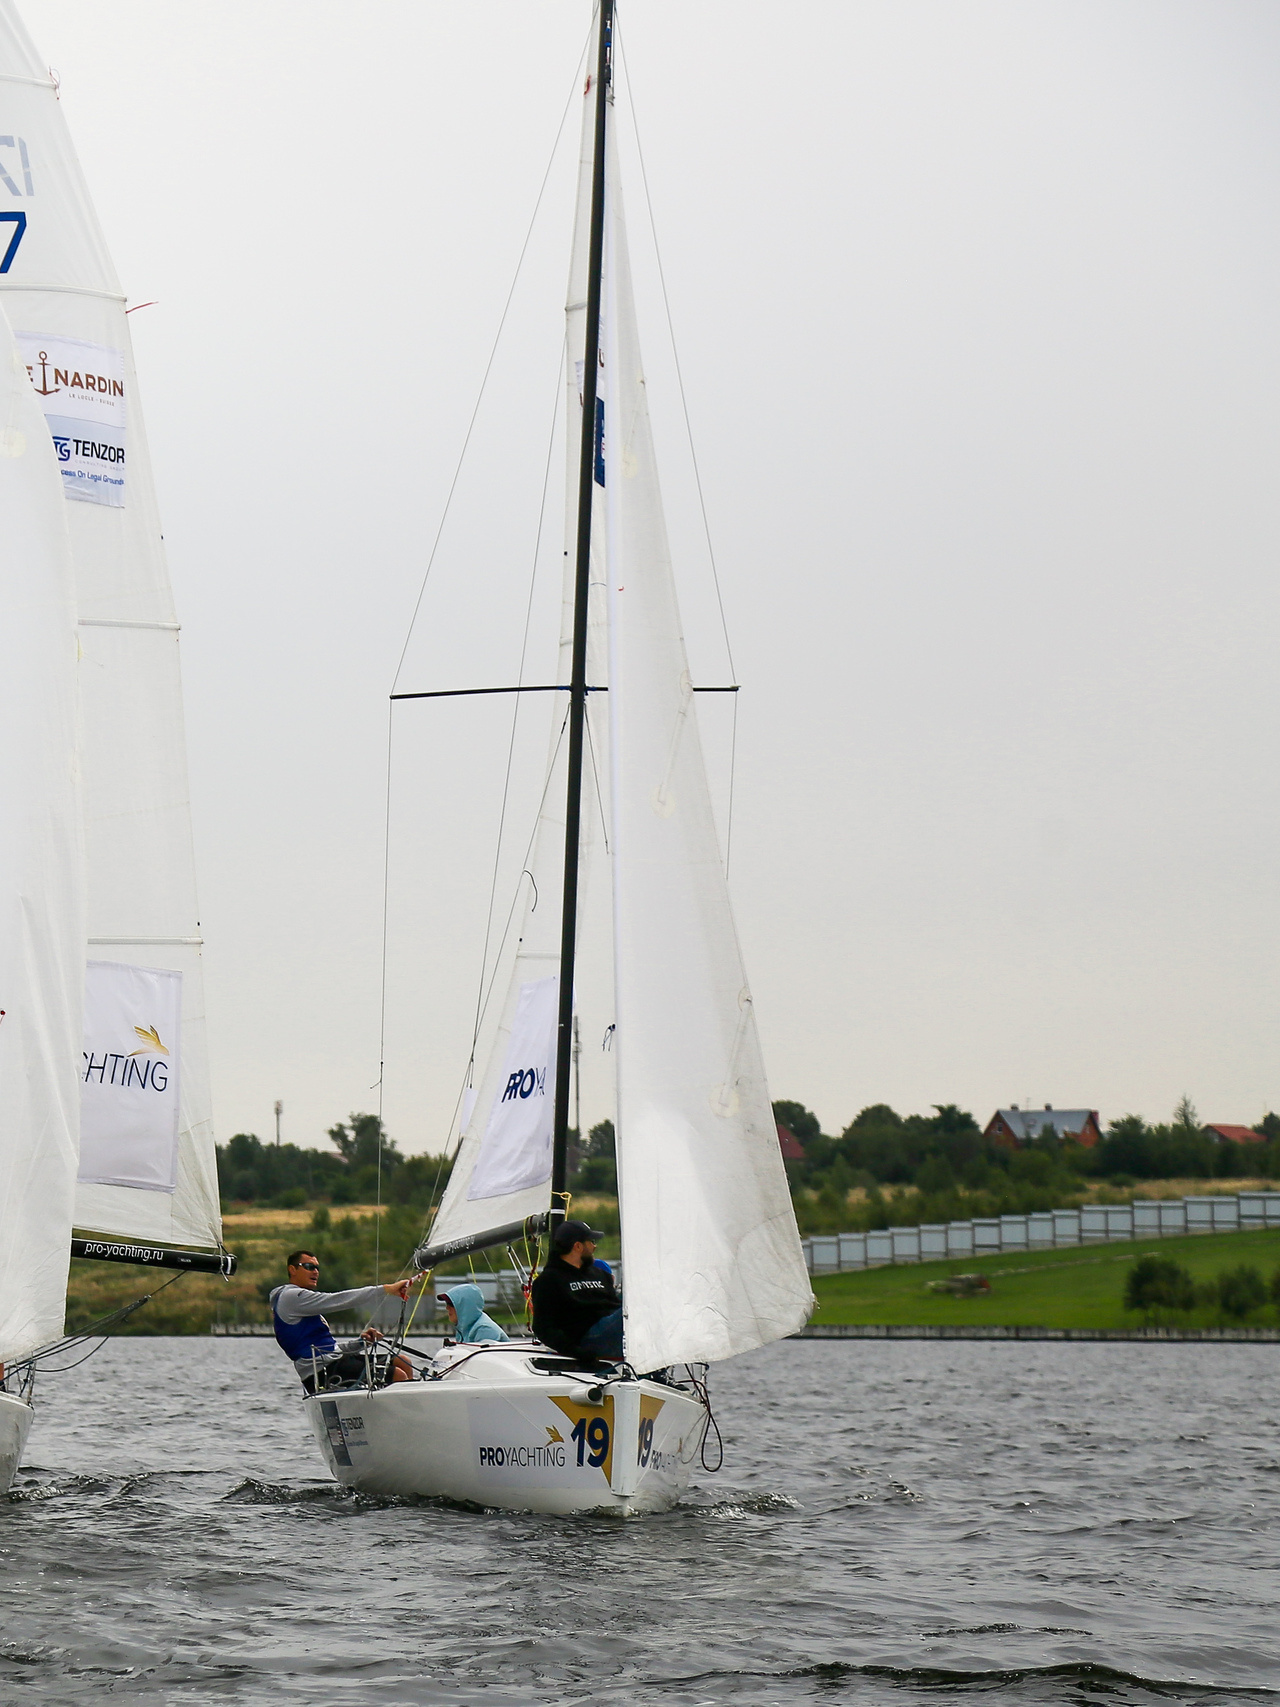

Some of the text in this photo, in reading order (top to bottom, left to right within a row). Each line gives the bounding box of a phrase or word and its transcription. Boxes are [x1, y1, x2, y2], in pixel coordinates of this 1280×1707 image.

[54, 367, 124, 397] NARDIN
[73, 439, 125, 463] TENZOR
[84, 1242, 164, 1262] pro-yachting.ru
[571, 1417, 609, 1468] 19
[480, 1447, 566, 1467] PROYACHTING
